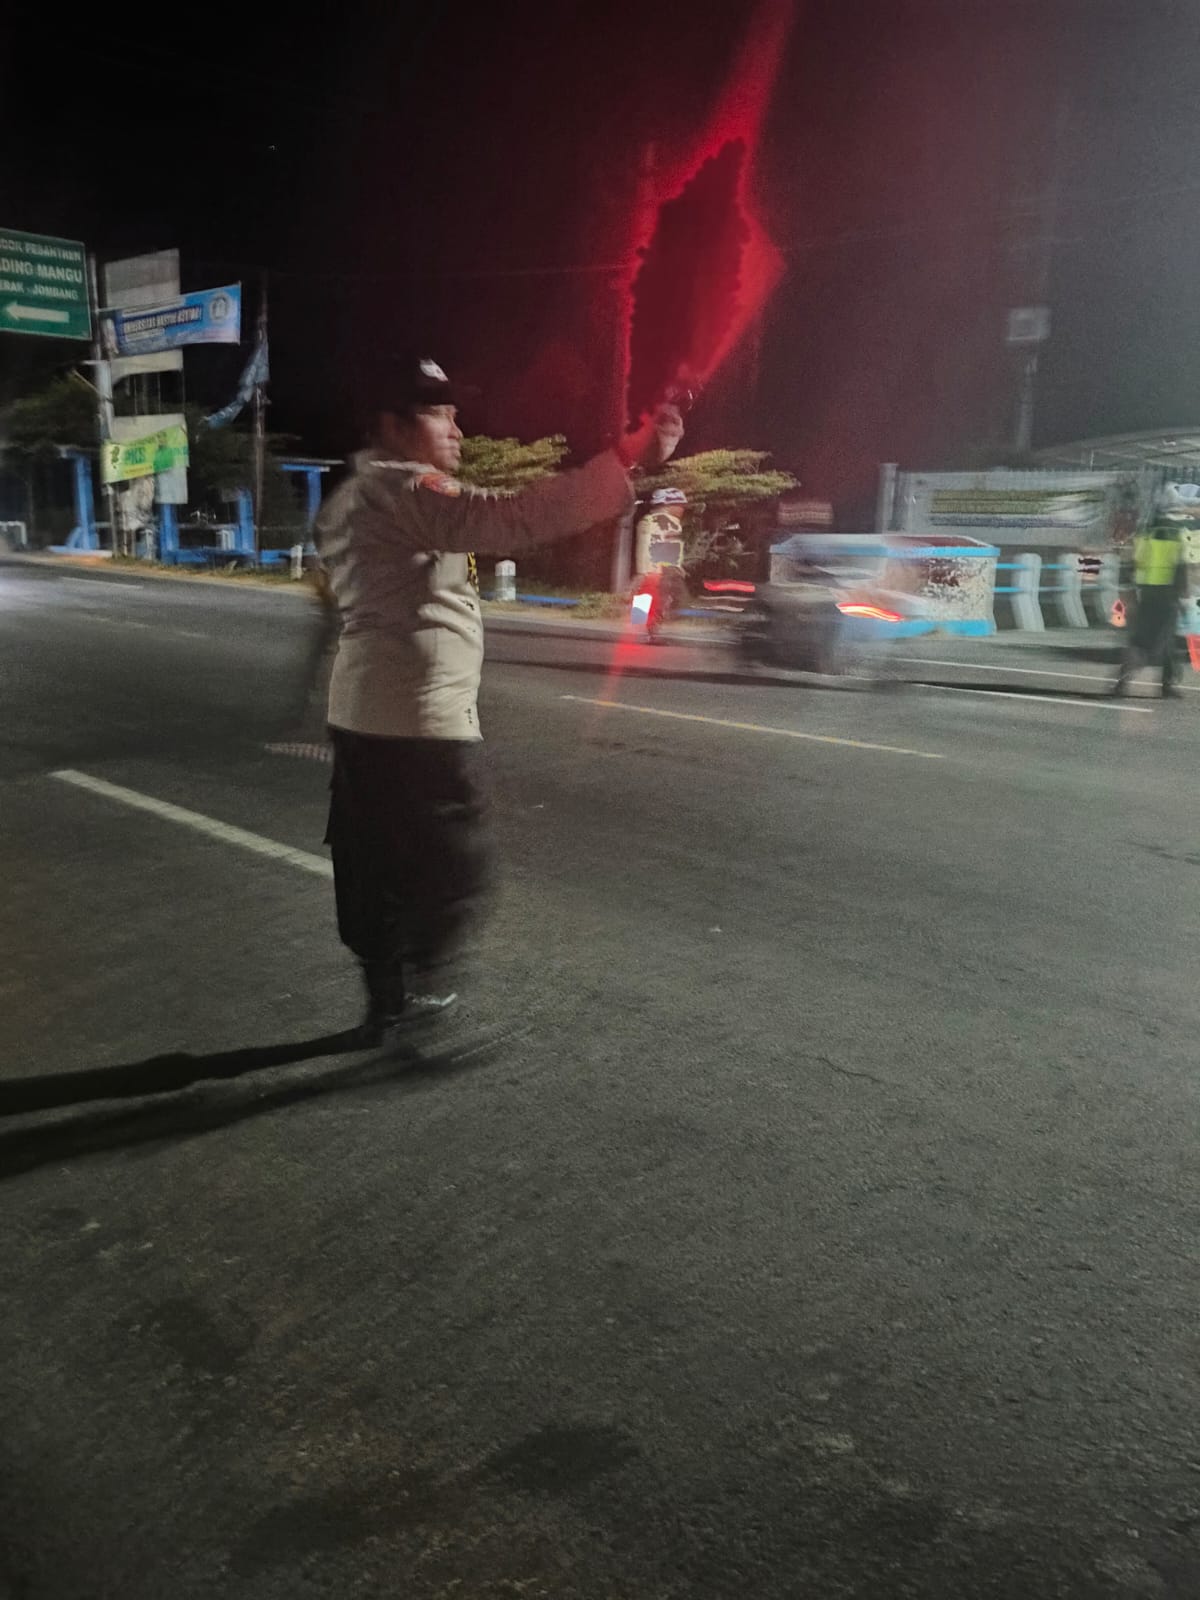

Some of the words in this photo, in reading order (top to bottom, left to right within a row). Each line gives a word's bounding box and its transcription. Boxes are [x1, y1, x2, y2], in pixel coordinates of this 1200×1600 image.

[0, 239, 23, 252] DOK
[0, 259, 33, 275] DING
[37, 264, 82, 284] MANGU
[33, 284, 79, 299] JOMBANG
